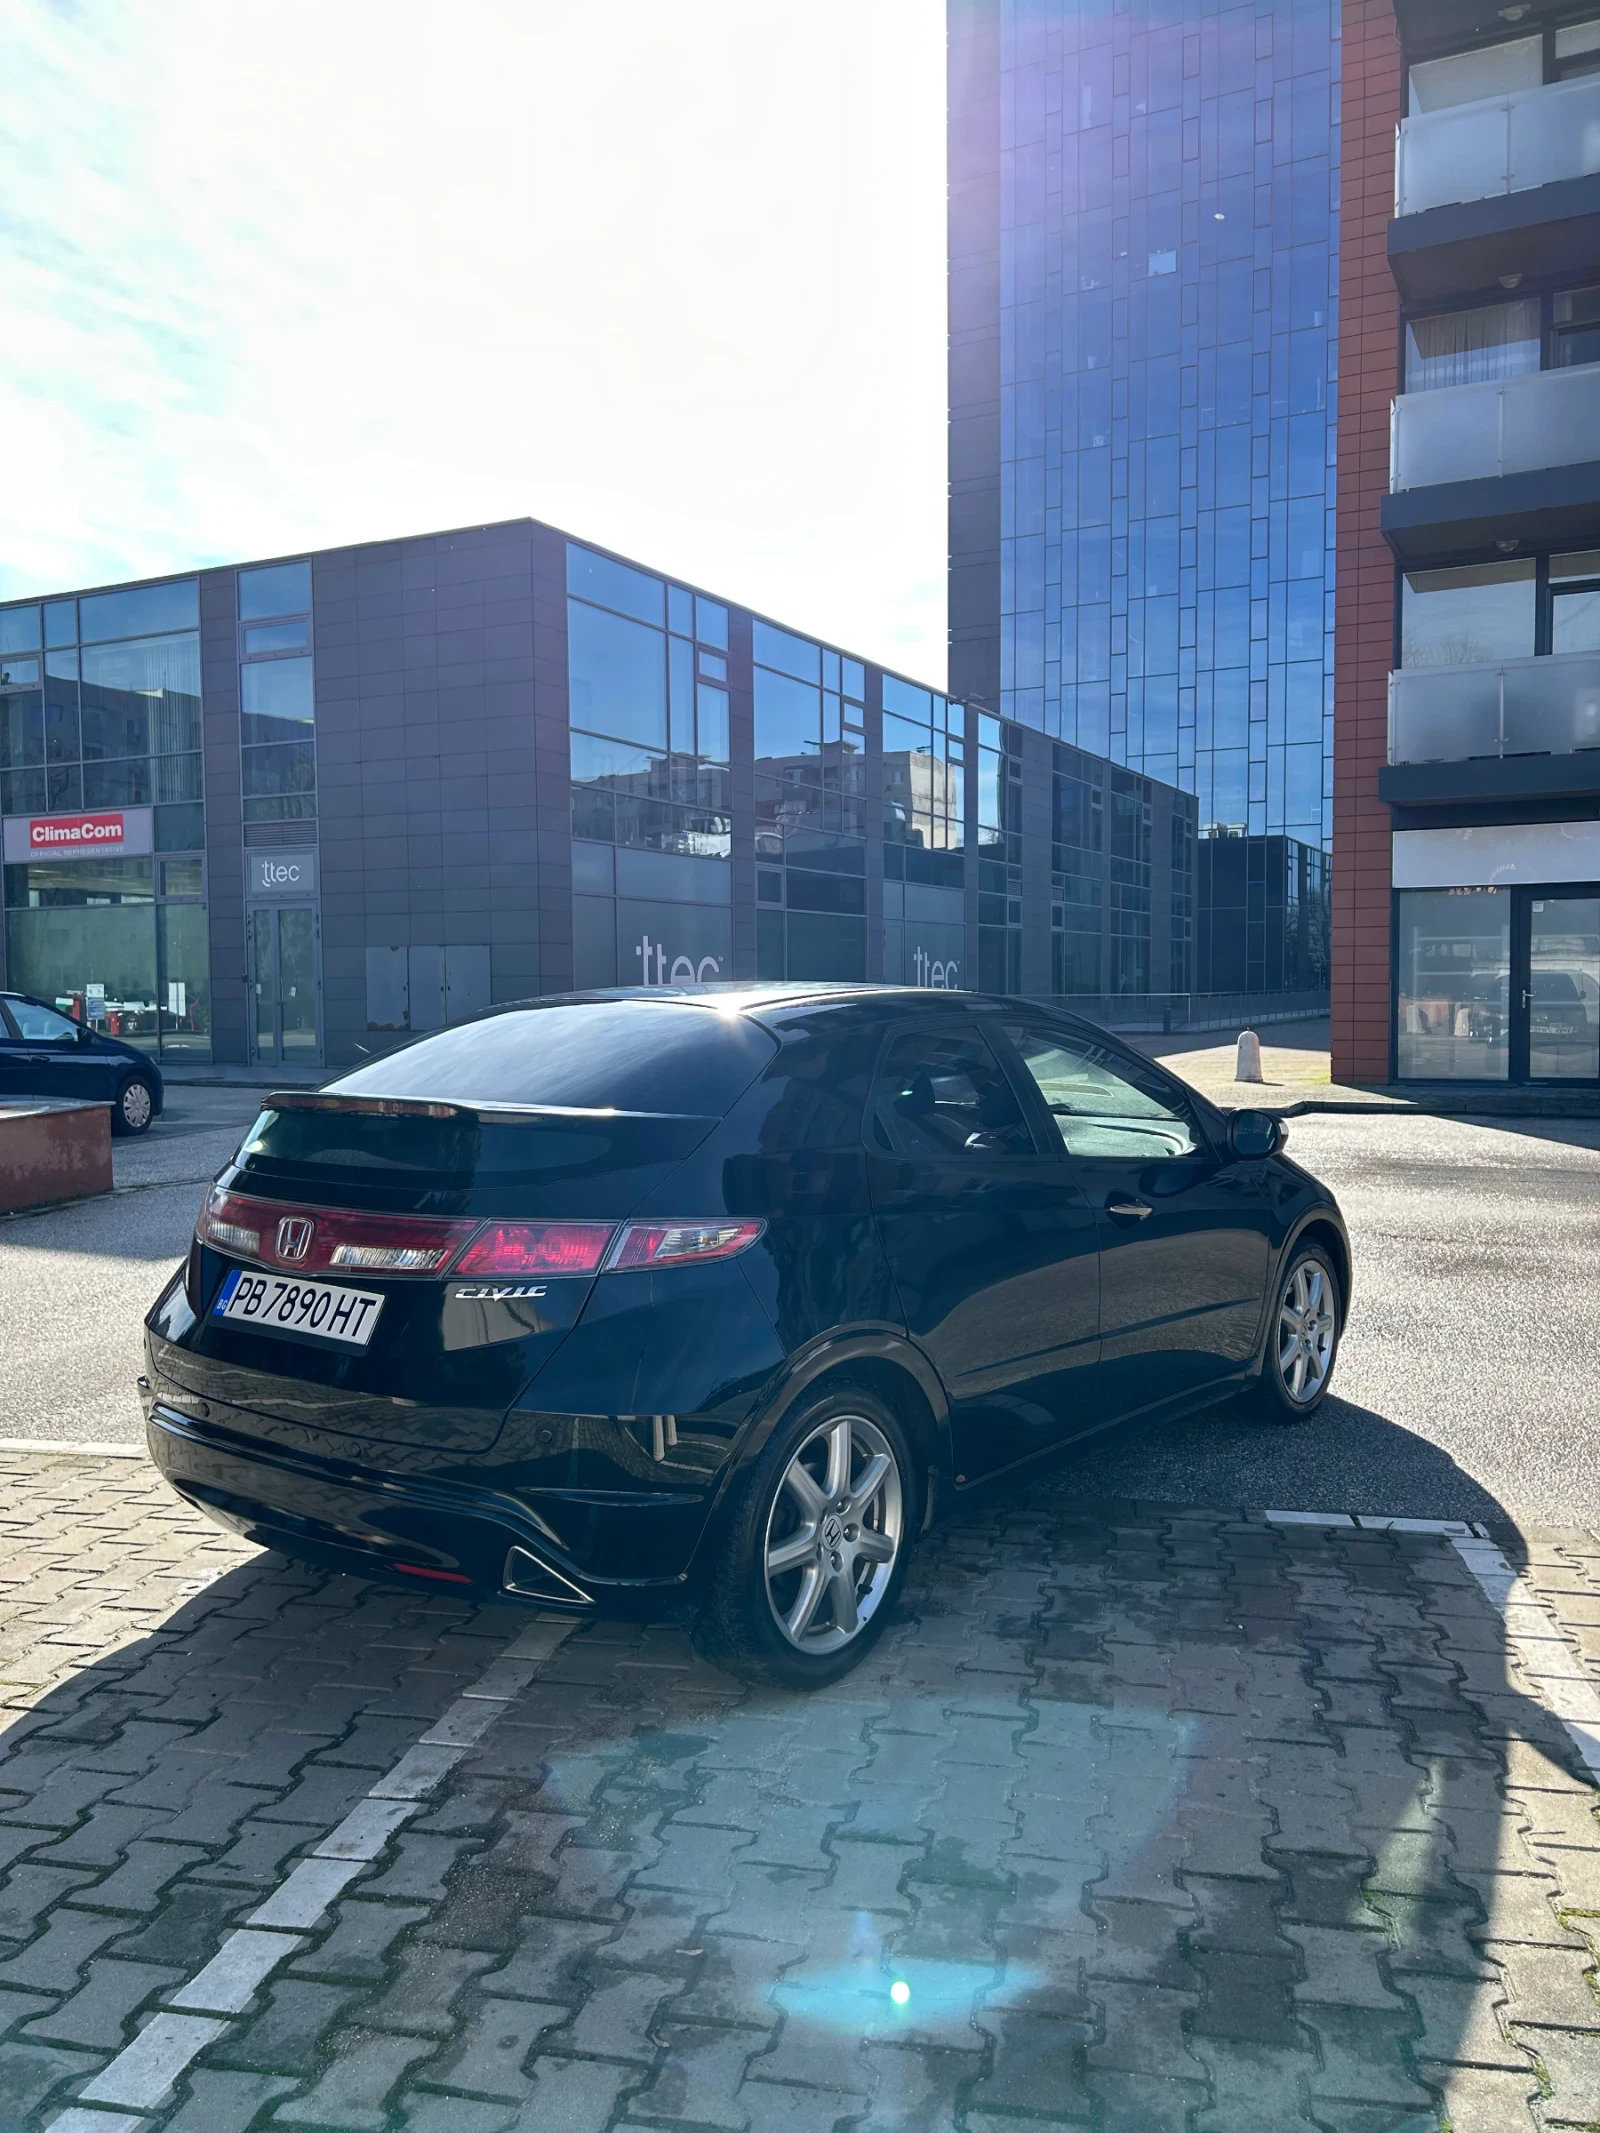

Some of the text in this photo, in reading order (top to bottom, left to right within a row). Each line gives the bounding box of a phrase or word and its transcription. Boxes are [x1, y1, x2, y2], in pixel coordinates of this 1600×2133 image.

[32, 823, 122, 842] ClimaCom
[30, 846, 123, 858] OFFICIAL REPRESENTATIVE
[262, 861, 300, 888] ttec
[455, 1286, 547, 1301] CIVIC
[217, 1299, 228, 1310] BG
